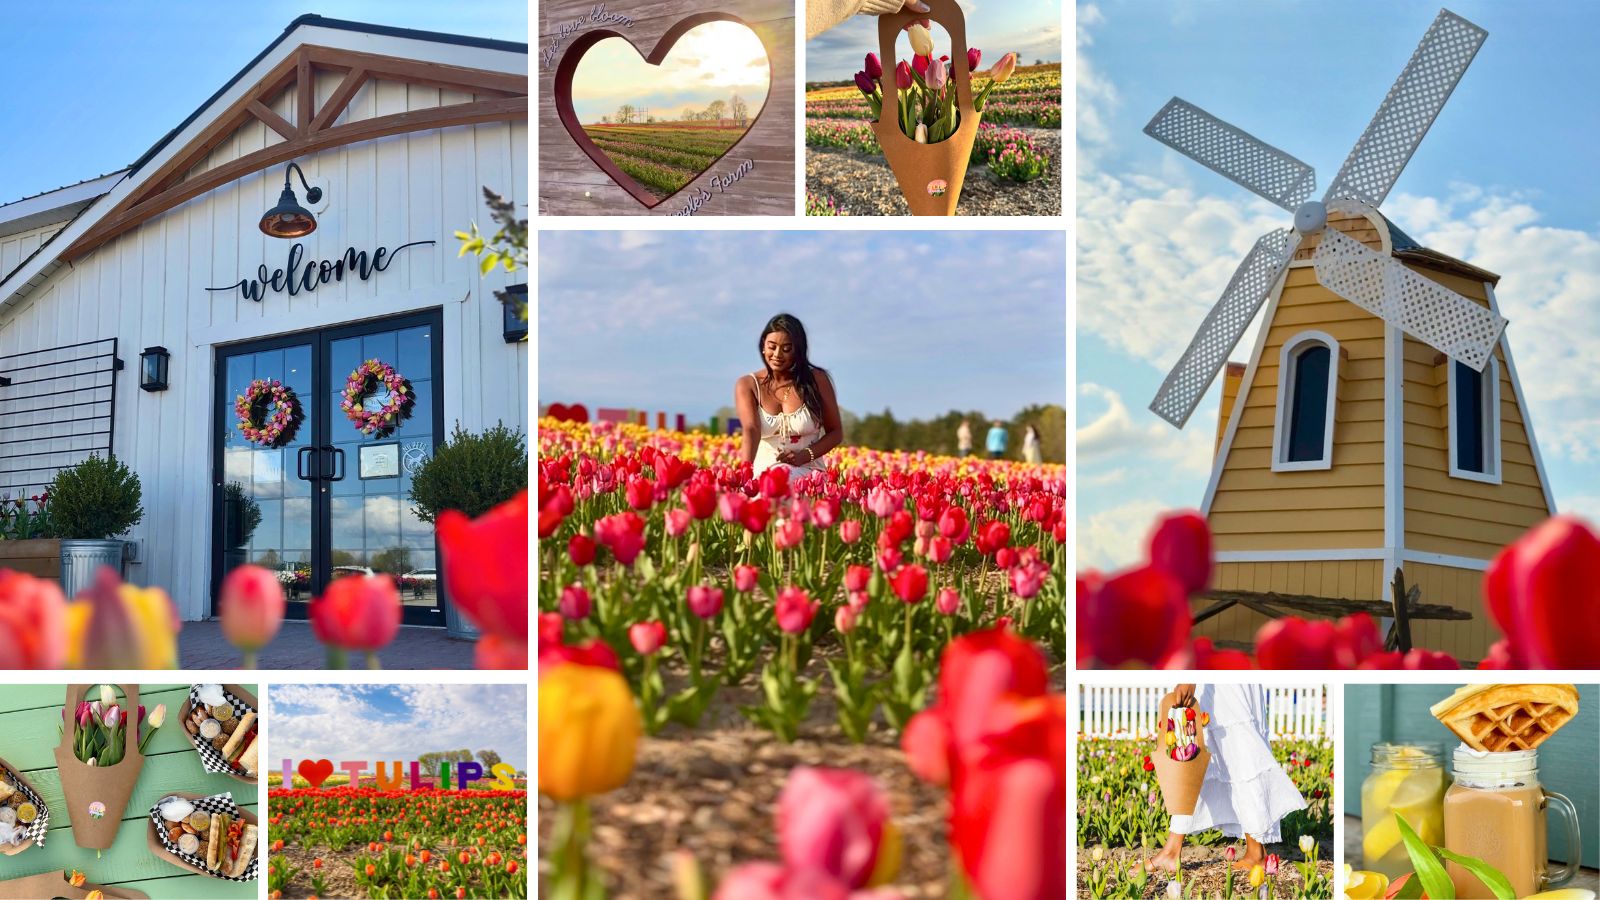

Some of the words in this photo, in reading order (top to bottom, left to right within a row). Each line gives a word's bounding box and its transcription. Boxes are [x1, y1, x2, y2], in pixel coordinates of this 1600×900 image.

[559, 15, 587, 39] love
[590, 3, 634, 28] bloom
[710, 158, 754, 193] Farm
[205, 242, 436, 302] welcome
[282, 758, 292, 790] I
[340, 760, 516, 791] TULIPS
